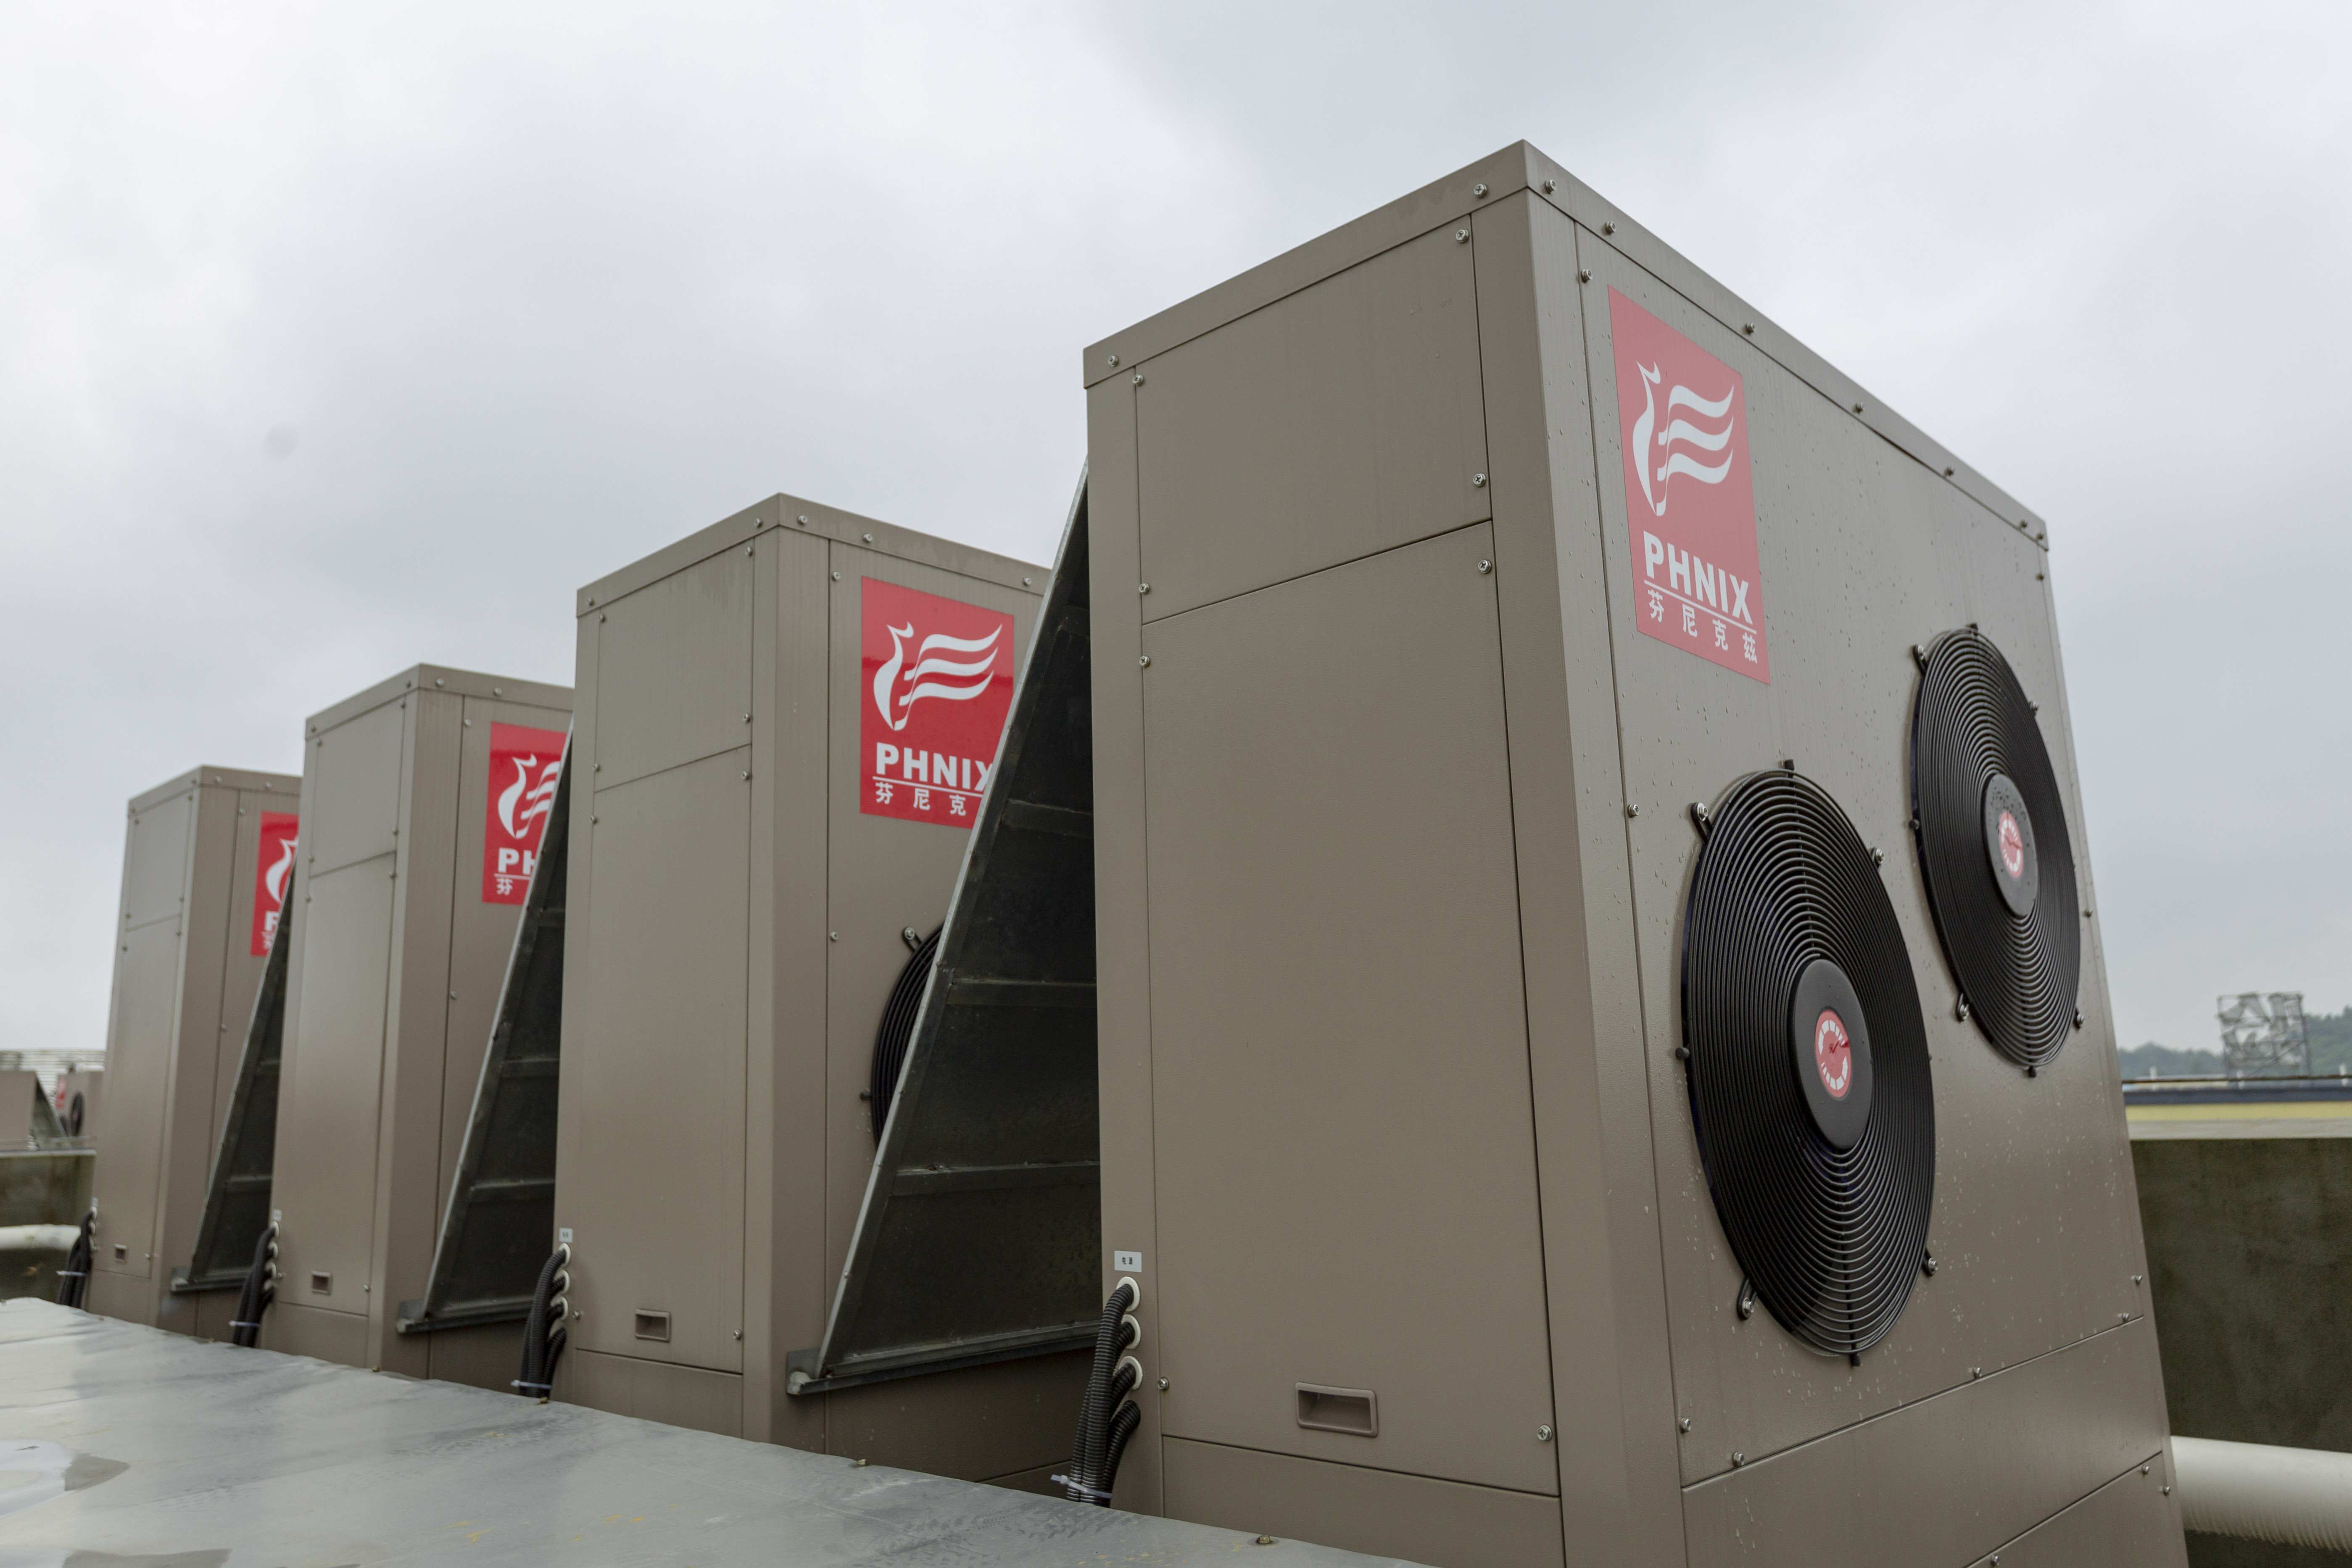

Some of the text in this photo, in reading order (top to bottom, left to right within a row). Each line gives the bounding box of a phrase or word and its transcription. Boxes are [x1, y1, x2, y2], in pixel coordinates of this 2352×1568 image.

[1643, 530, 1753, 625] PHNIX
[1648, 589, 1758, 664] 芬尼克兹
